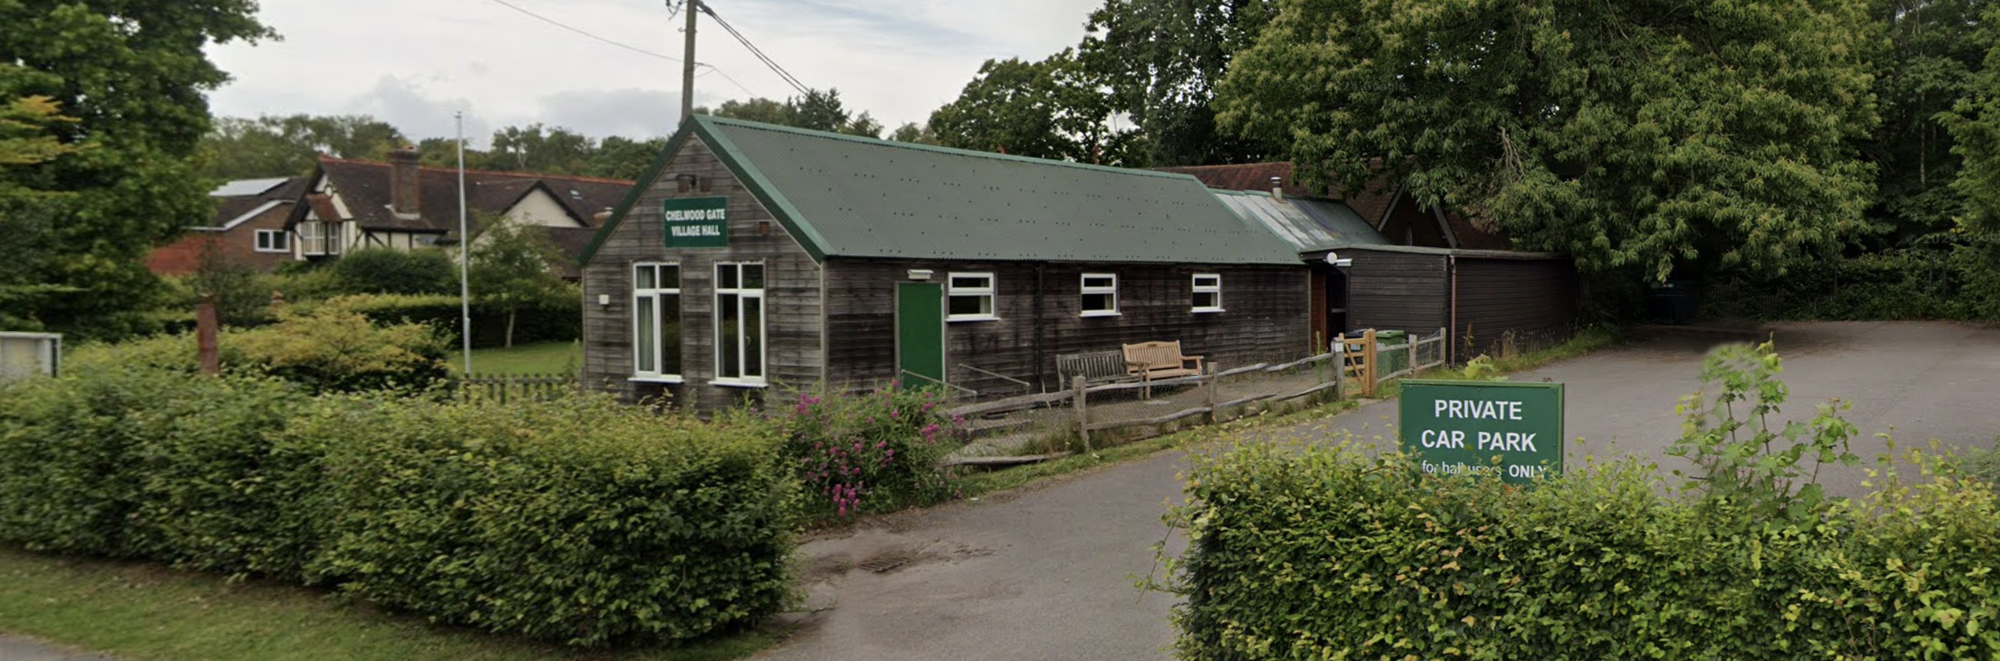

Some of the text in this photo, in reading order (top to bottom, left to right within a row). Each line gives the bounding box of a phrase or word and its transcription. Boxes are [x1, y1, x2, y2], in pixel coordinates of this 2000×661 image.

[665, 208, 725, 221] CHELWOOD GATE
[671, 224, 721, 237] VILLAGE HALL
[1434, 399, 1523, 421] PRIVATE
[1421, 429, 1537, 453] CAR PARK
[1441, 461, 1464, 475] hal
[1508, 464, 1546, 479] ONLY
